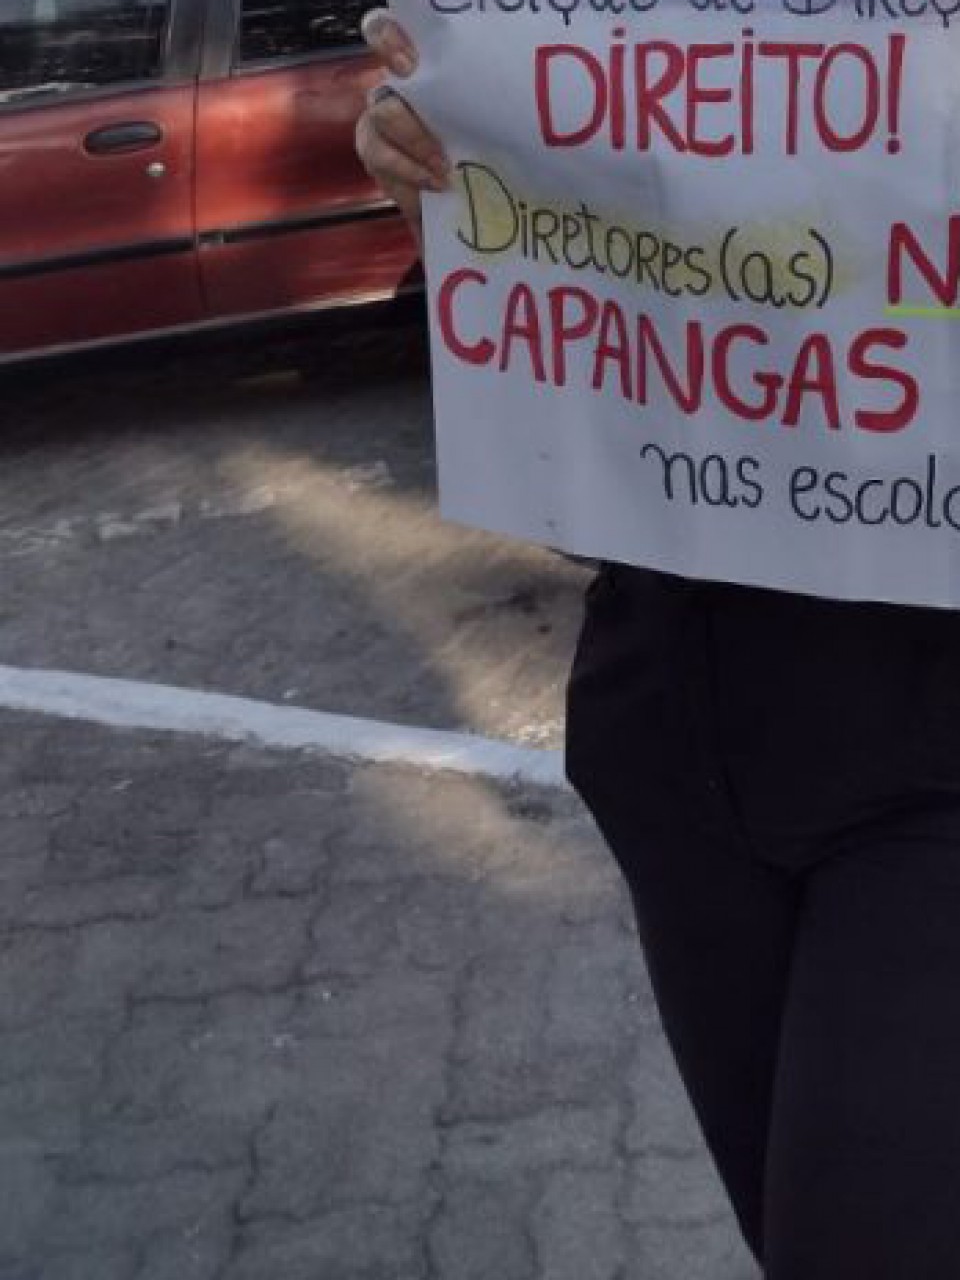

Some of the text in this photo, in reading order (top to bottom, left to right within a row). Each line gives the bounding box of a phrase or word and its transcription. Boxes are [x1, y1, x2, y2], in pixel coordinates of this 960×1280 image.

[535, 28, 906, 157] DIREITO!
[438, 268, 920, 433] CAPANGAS
[640, 443, 764, 508] nas
